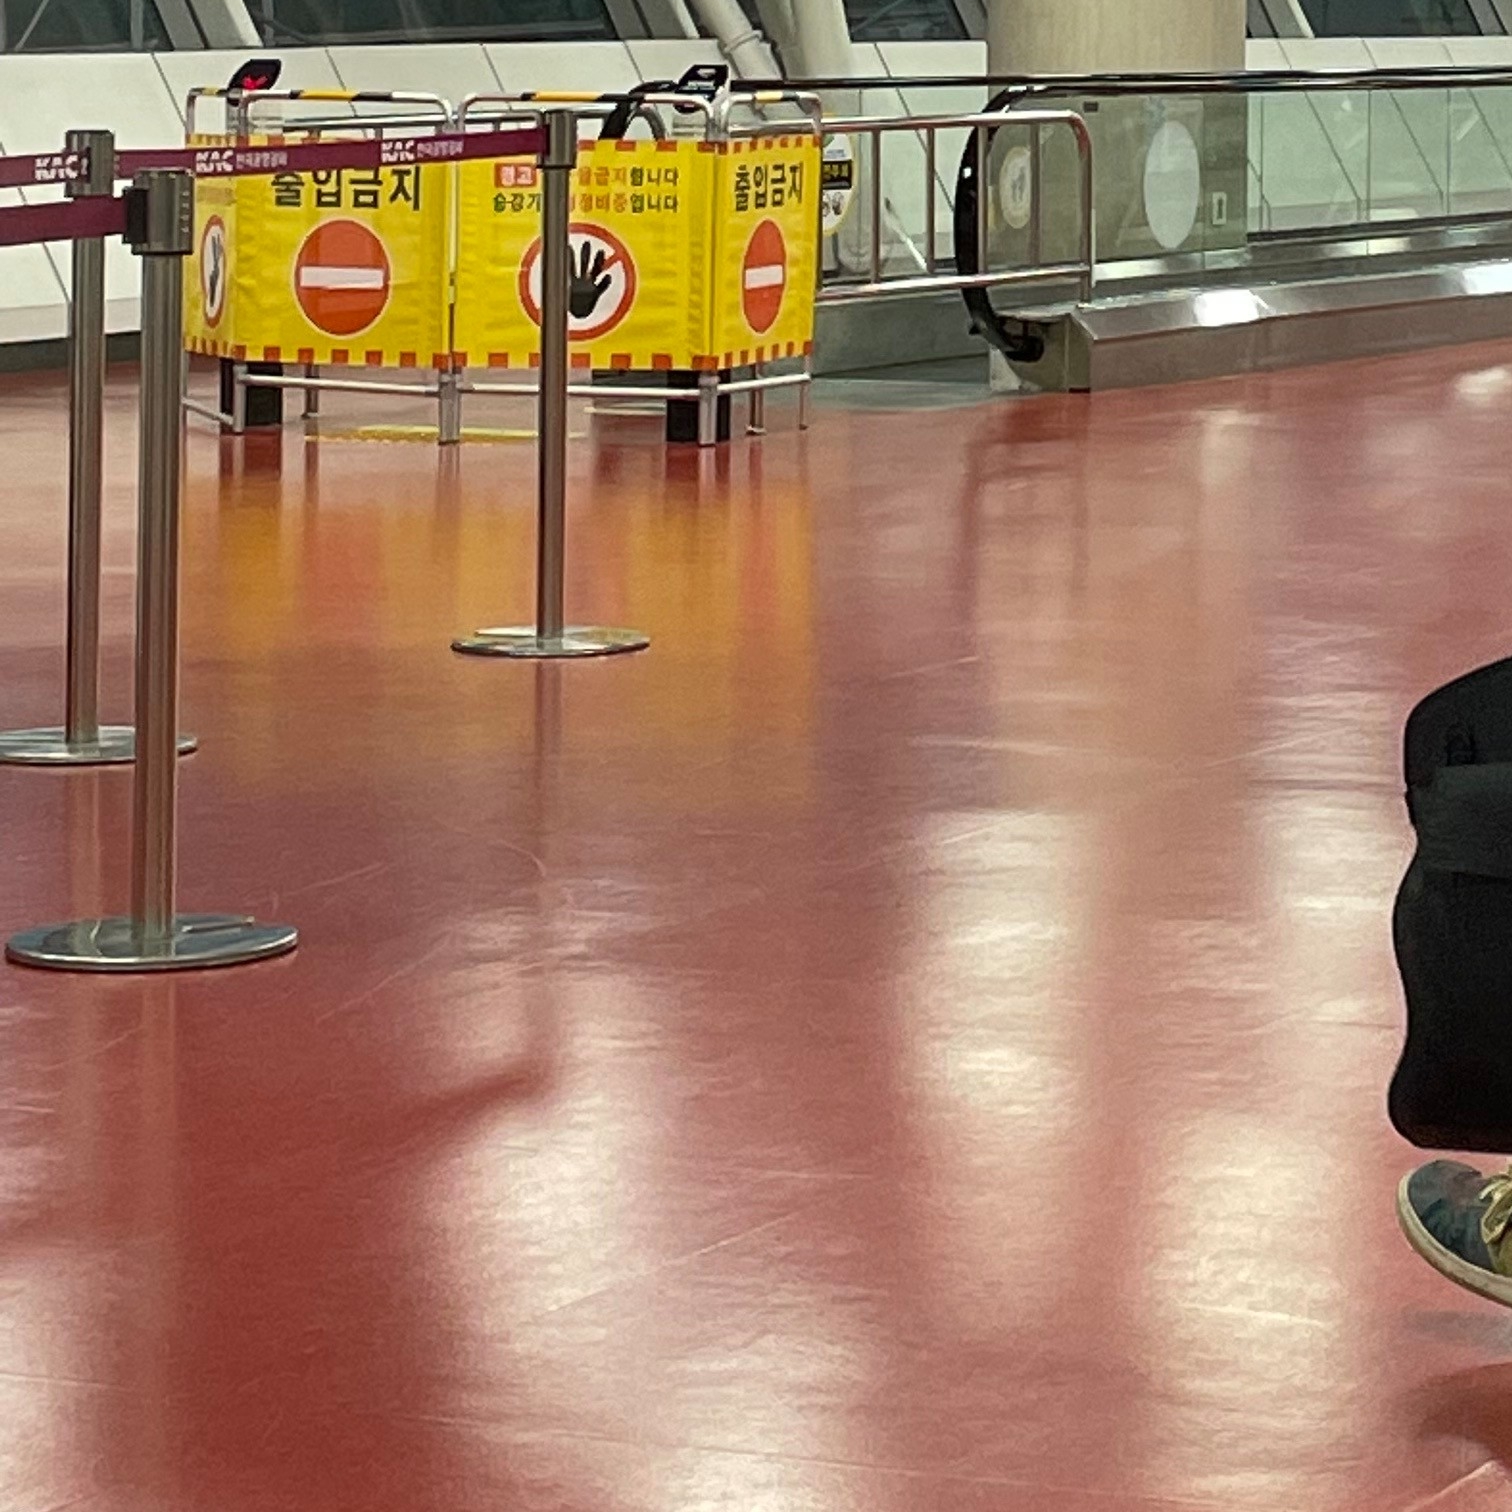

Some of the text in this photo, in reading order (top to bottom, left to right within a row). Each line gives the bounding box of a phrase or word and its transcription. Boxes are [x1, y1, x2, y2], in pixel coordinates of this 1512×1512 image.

[196, 150, 234, 173] KAC
[382, 139, 415, 163] KAC
[35, 155, 79, 180] KAC
[569, 166, 679, 187] 입금지합니다
[271, 165, 420, 211] 출입금지
[735, 162, 803, 212] 출입금지
[494, 192, 541, 213] 승강기
